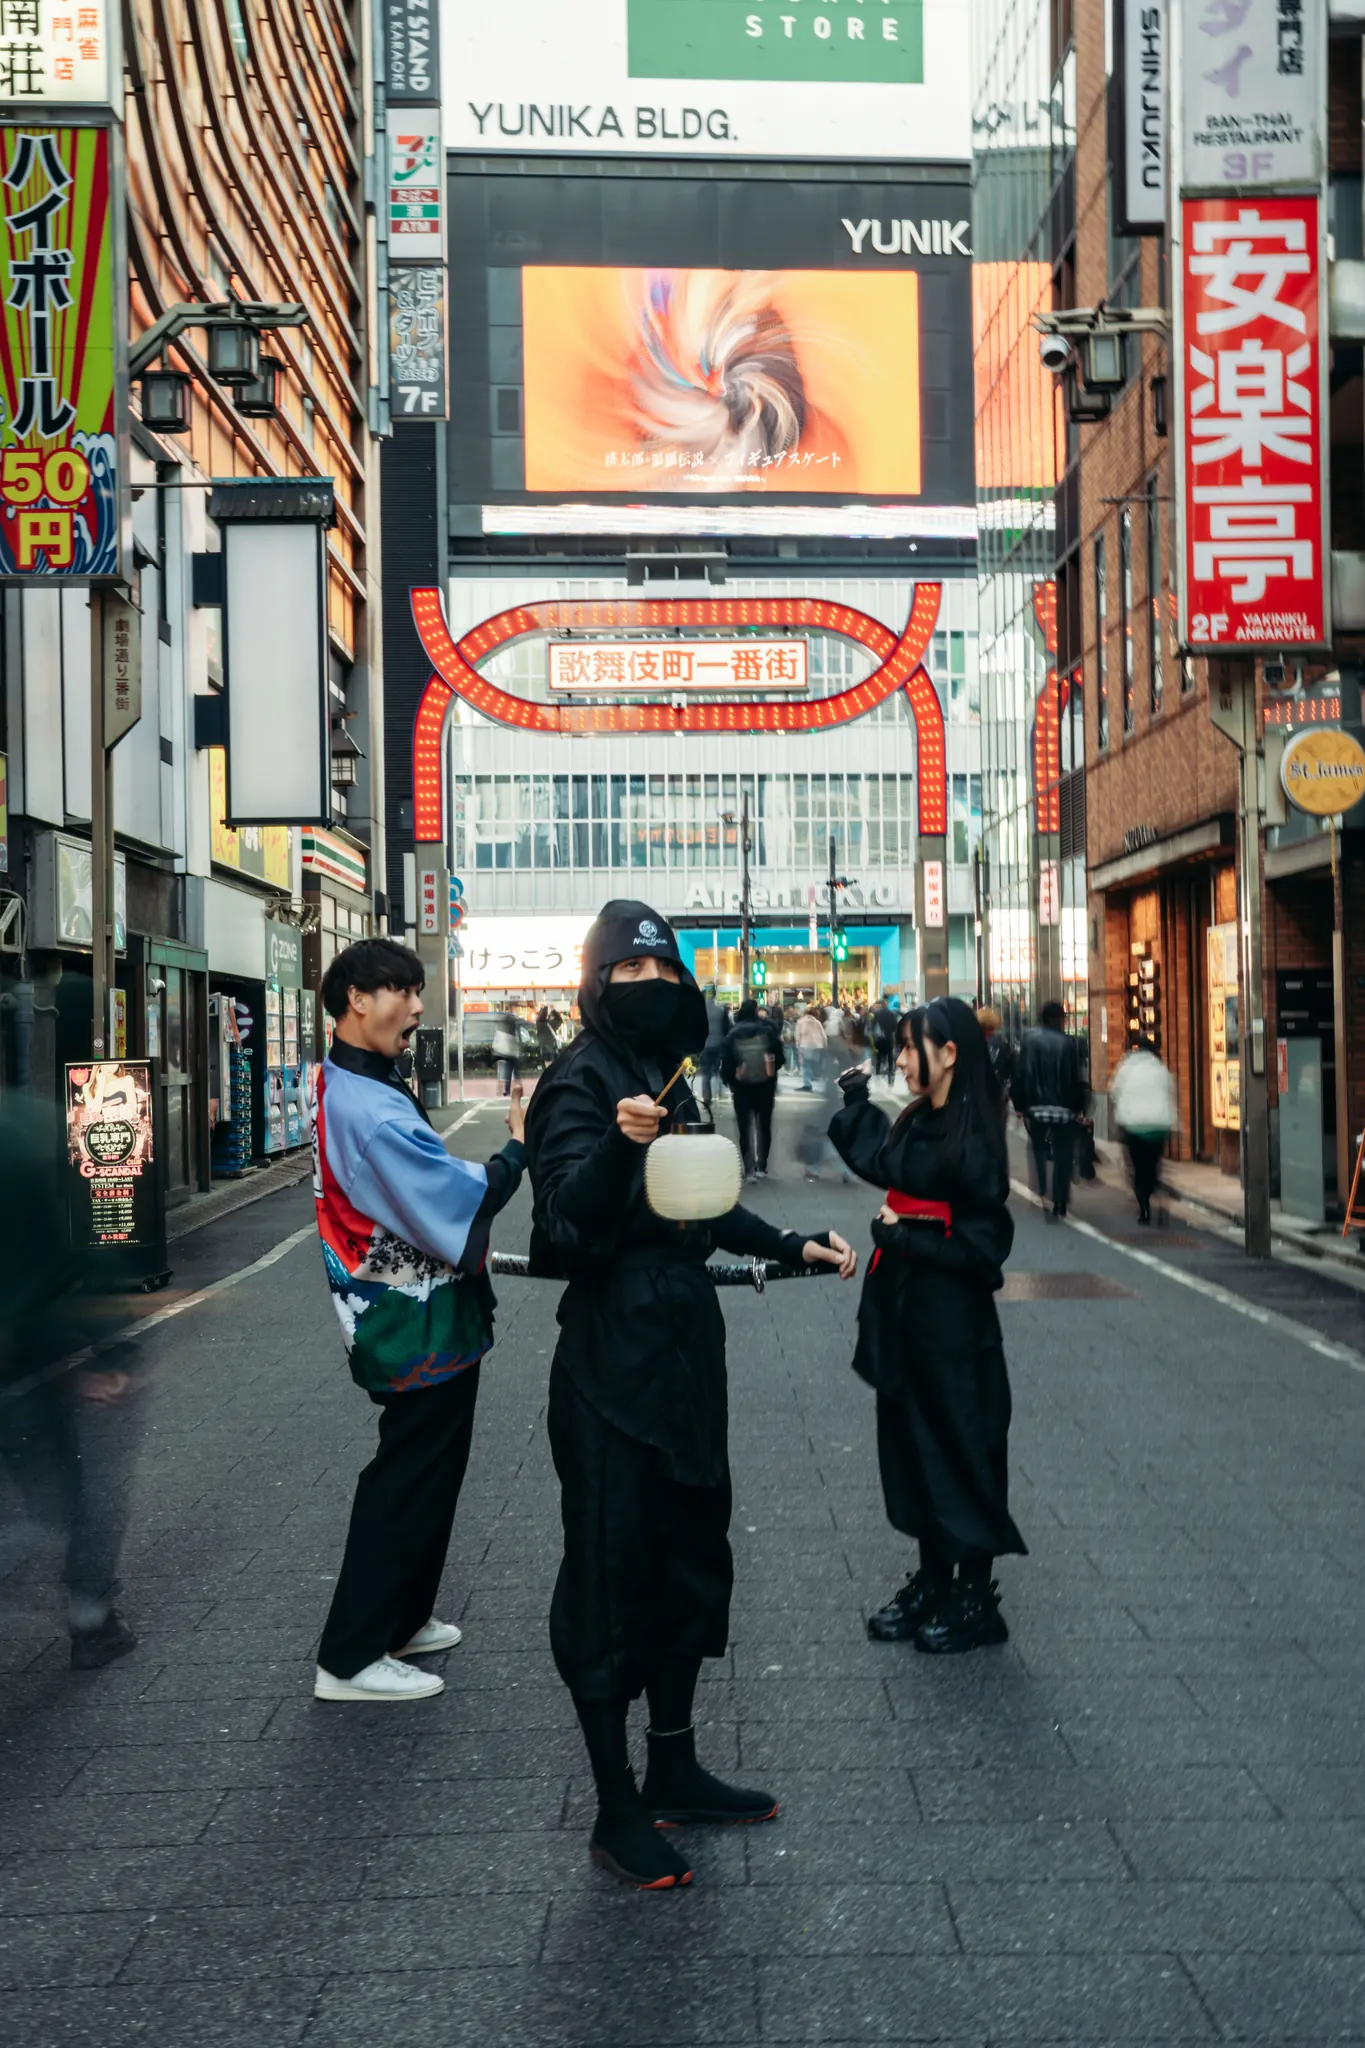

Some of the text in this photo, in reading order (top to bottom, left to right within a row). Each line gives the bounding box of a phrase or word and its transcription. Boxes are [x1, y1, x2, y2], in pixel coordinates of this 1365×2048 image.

[745, 15, 900, 42] STORE
[390, 21, 405, 91] KARAOKE
[407, 15, 431, 92] STAND
[1141, 6, 1161, 190] SHINJUKU
[468, 102, 739, 141] YUNIKA BLDG.
[1193, 129, 1304, 148] RESTAURANT
[399, 221, 432, 233] ATM
[841, 218, 974, 256] YUNIK
[2, 133, 76, 440] ハイボール
[398, 386, 439, 413] 7F
[1188, 209, 1313, 604] 安楽亭
[17, 510, 74, 568] 円
[1191, 613, 1316, 642] 2F ANRAKUTEI
[1241, 612, 1307, 626] YAKINIKU
[114, 618, 130, 711] 劇場通り一番街
[557, 648, 799, 684] 歌舞伎町一番街
[423, 873, 435, 929] 劇場通り
[683, 881, 791, 918] Alpen
[469, 946, 563, 970] けっこう
[90, 1131, 131, 1144] 巨乳専門
[80, 1160, 143, 1178] G-SCANDAL
